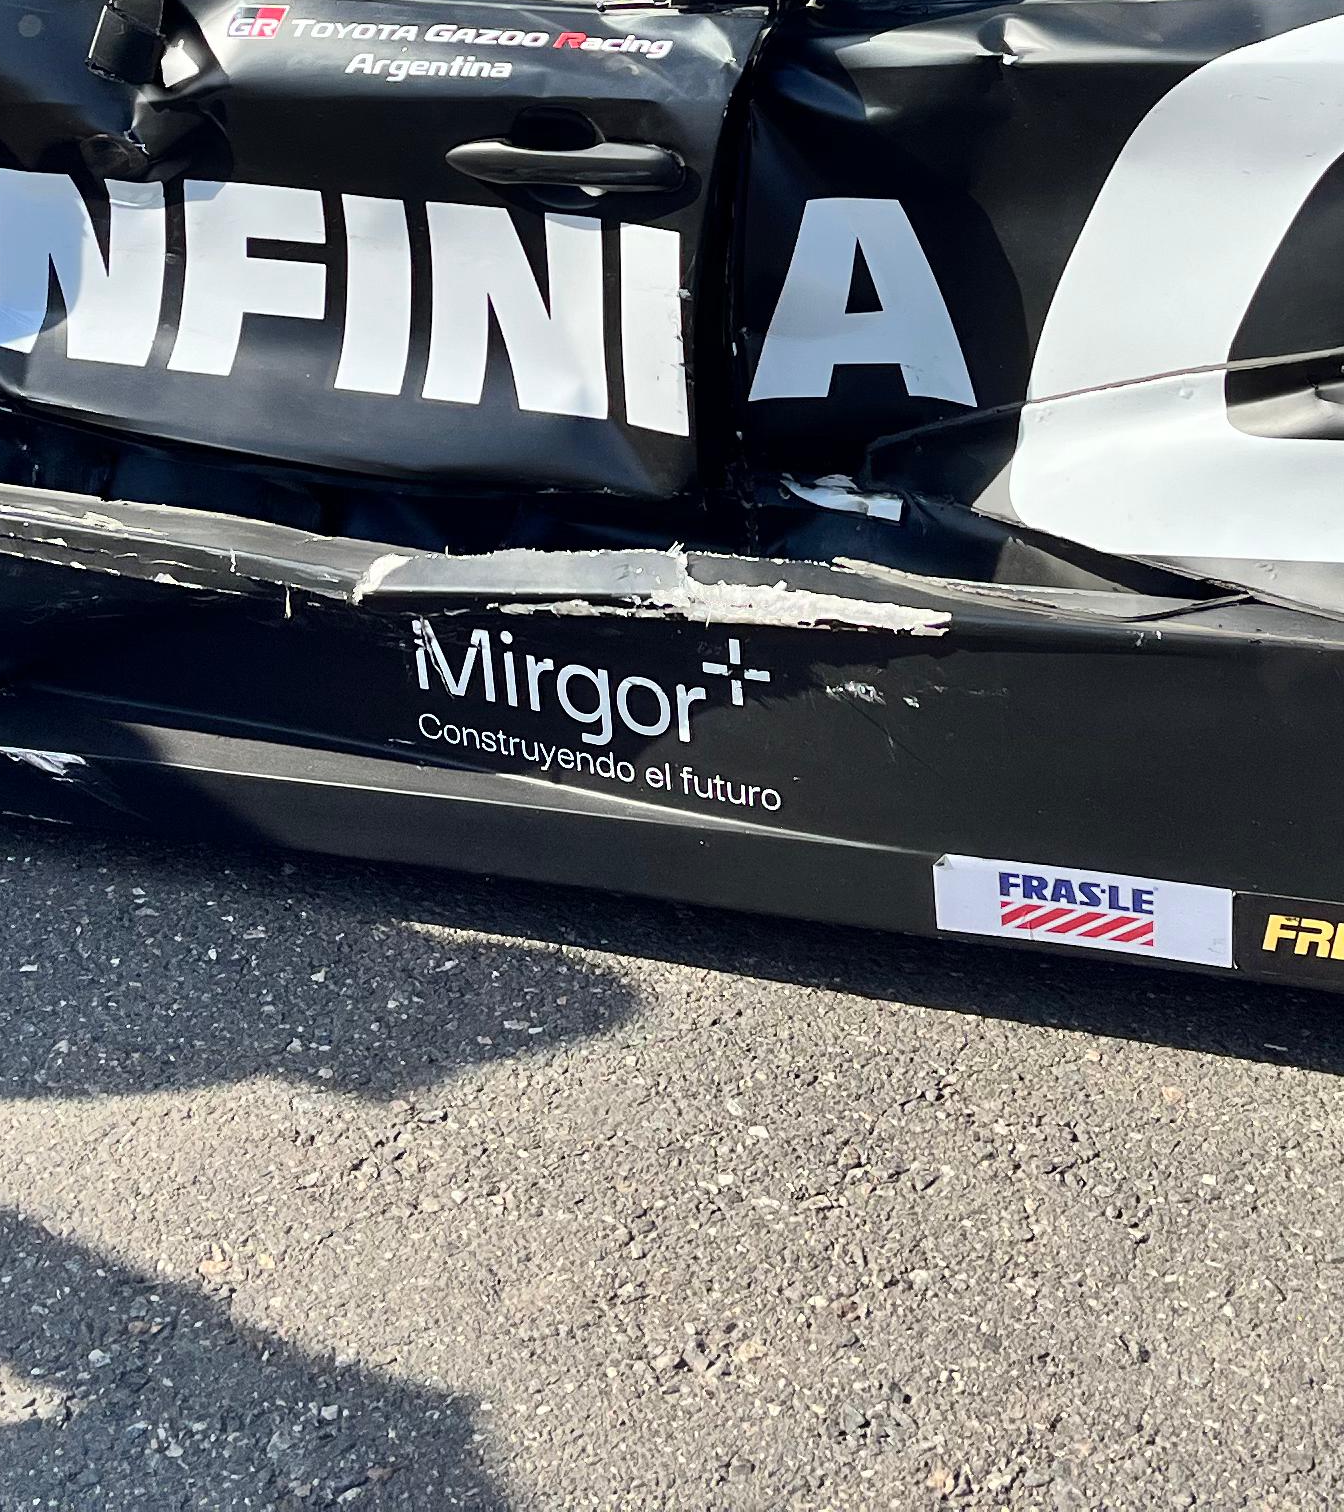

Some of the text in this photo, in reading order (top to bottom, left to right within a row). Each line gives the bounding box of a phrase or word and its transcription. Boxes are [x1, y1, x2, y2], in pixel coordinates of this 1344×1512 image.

[291, 18, 417, 42] TOYOTA
[423, 23, 550, 49] GAZOO
[552, 31, 675, 60] Racing
[343, 52, 514, 83] Argentina
[411, 619, 707, 746] Mirgor
[418, 713, 783, 811] Construyendo el futuro
